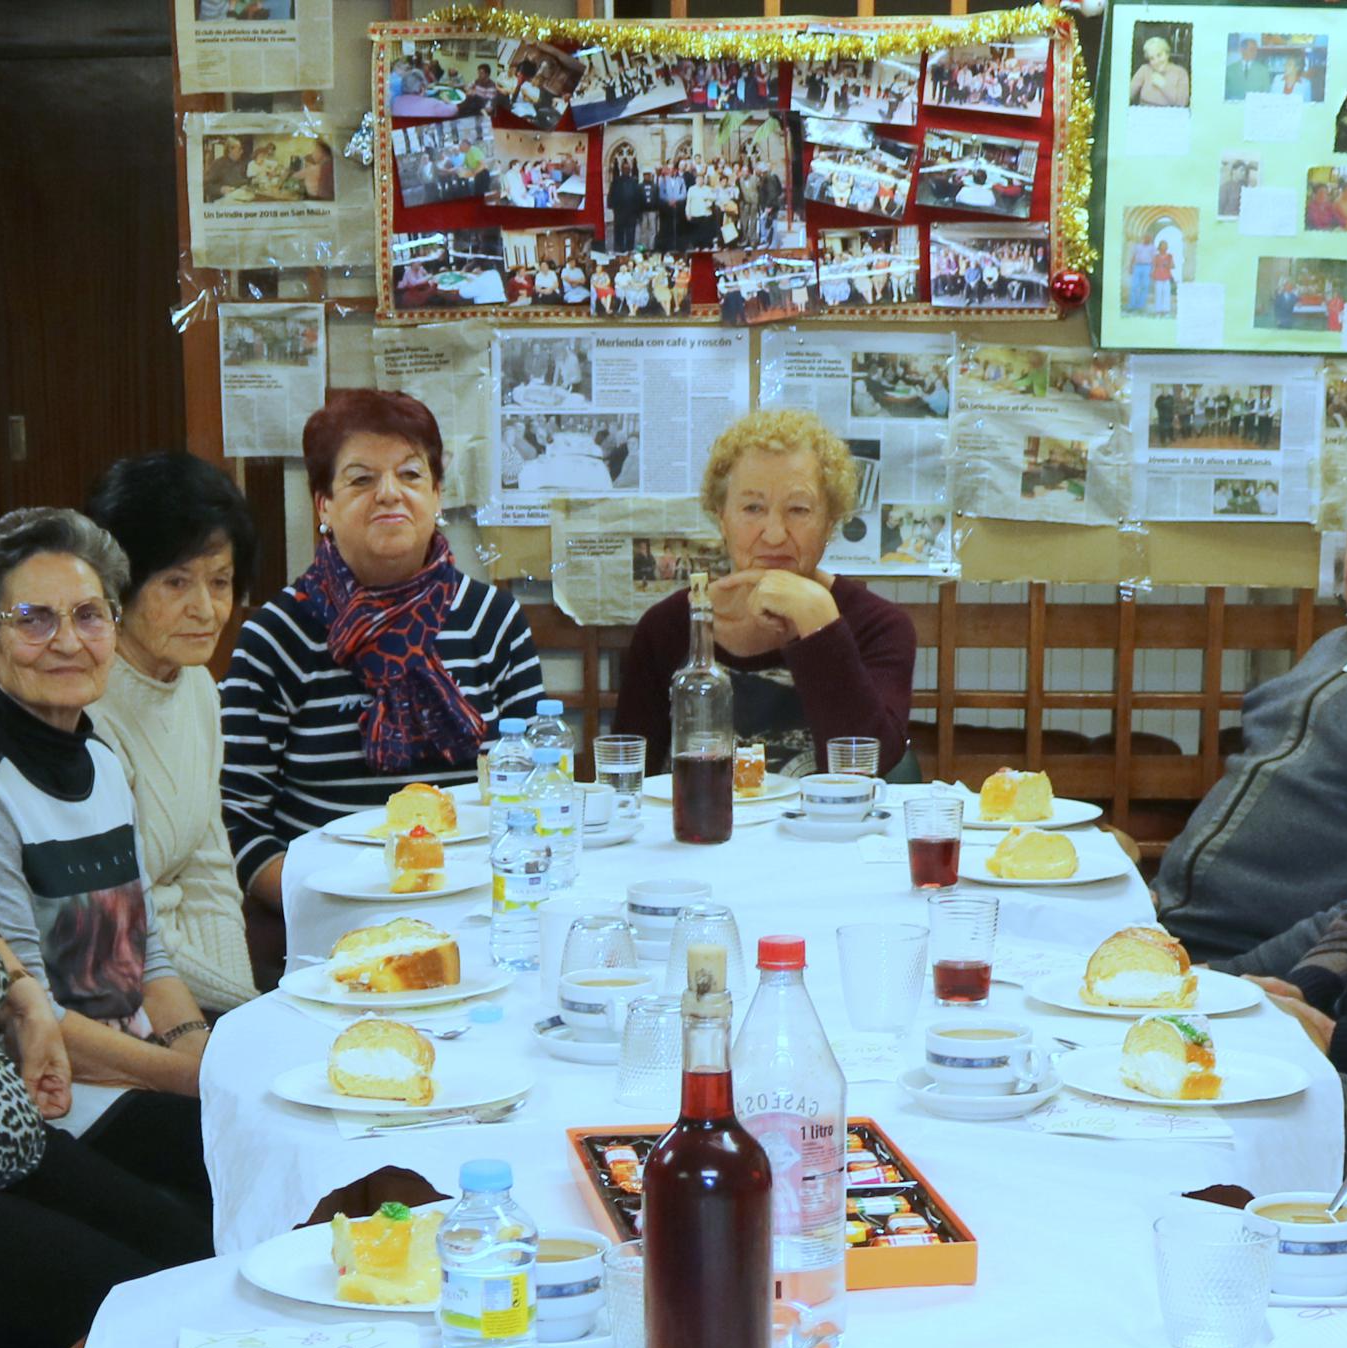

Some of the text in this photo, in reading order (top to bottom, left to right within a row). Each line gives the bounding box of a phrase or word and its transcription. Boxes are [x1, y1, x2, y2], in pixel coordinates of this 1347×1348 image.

[203, 210, 215, 219] Un
[215, 209, 243, 219] brindis
[244, 212, 258, 221] por
[259, 210, 278, 218] 2018
[290, 208, 306, 218] San
[595, 336, 732, 350] Merienda con café y roscón
[1148, 456, 1180, 465] Jóvenes
[1181, 456, 1191, 464] de
[1193, 457, 1204, 465] 80
[1206, 457, 1225, 465] años
[1237, 457, 1272, 466] Baltanás
[501, 503, 515, 511] Los
[800, 1123, 834, 1142] 1 litro
